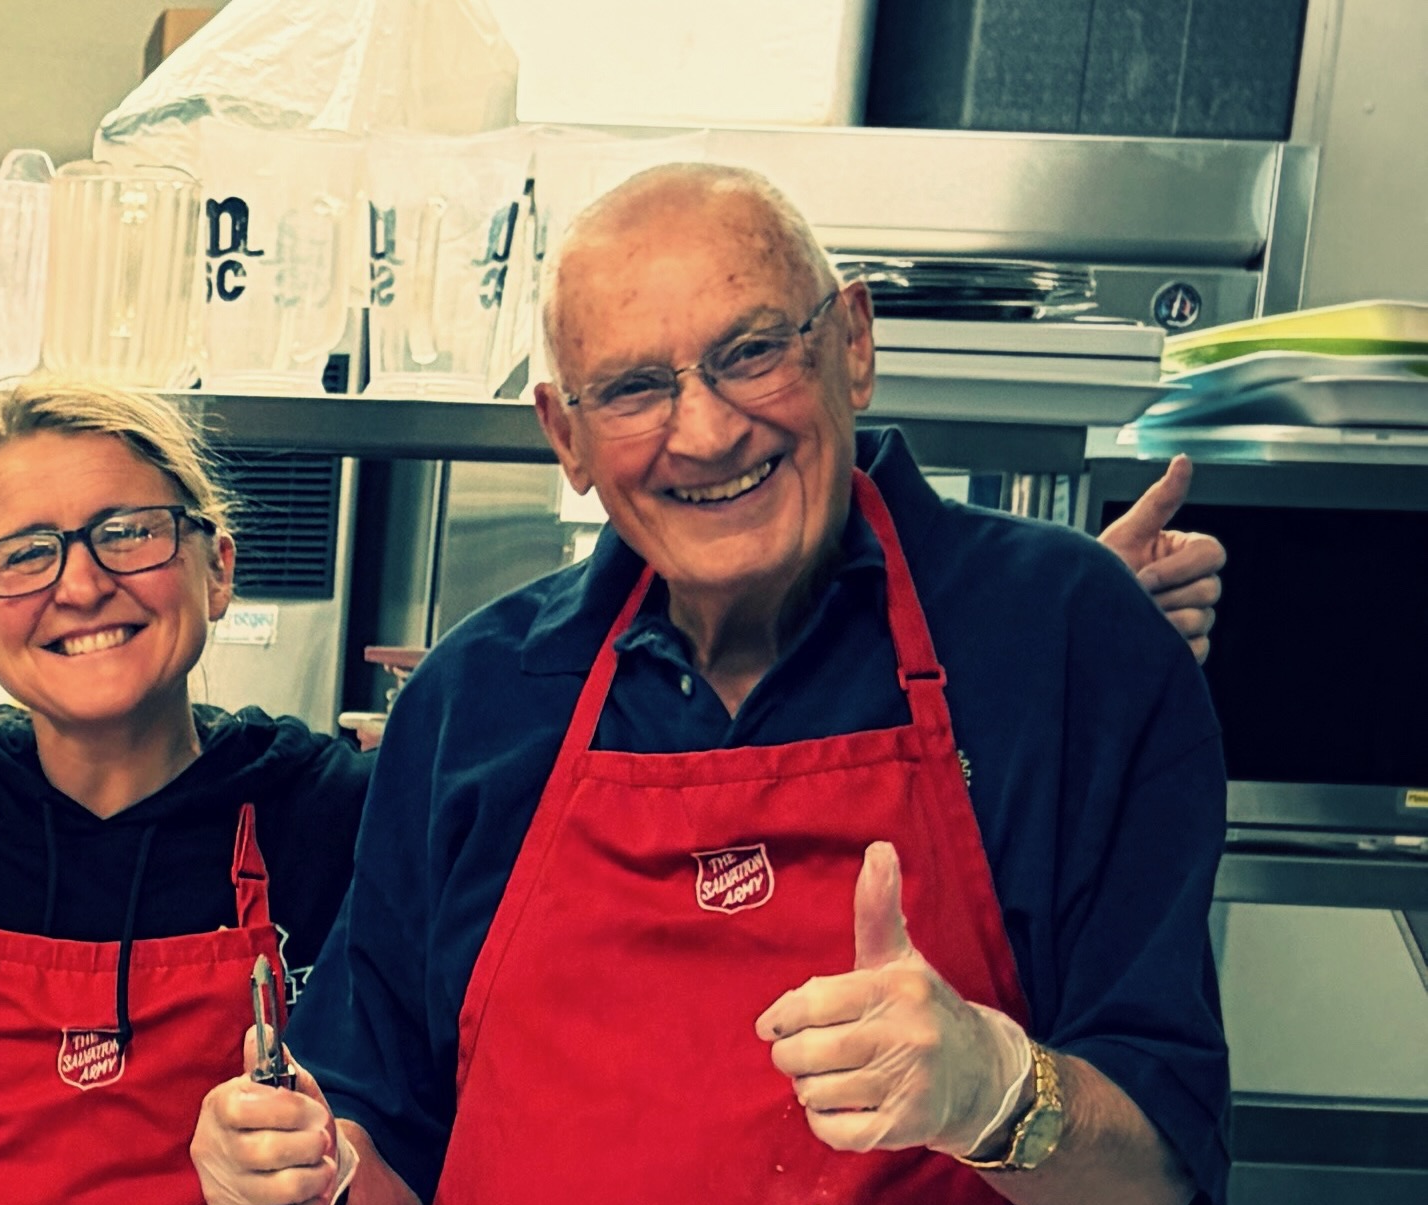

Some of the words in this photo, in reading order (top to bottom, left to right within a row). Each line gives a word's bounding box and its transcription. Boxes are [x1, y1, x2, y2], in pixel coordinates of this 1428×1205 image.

[702, 852, 764, 900] SALVATION
[708, 853, 737, 874] THE
[722, 872, 763, 907] ARMY
[62, 1038, 119, 1072] SALVATION
[73, 1032, 98, 1050] THE
[78, 1055, 117, 1082] ARMY
